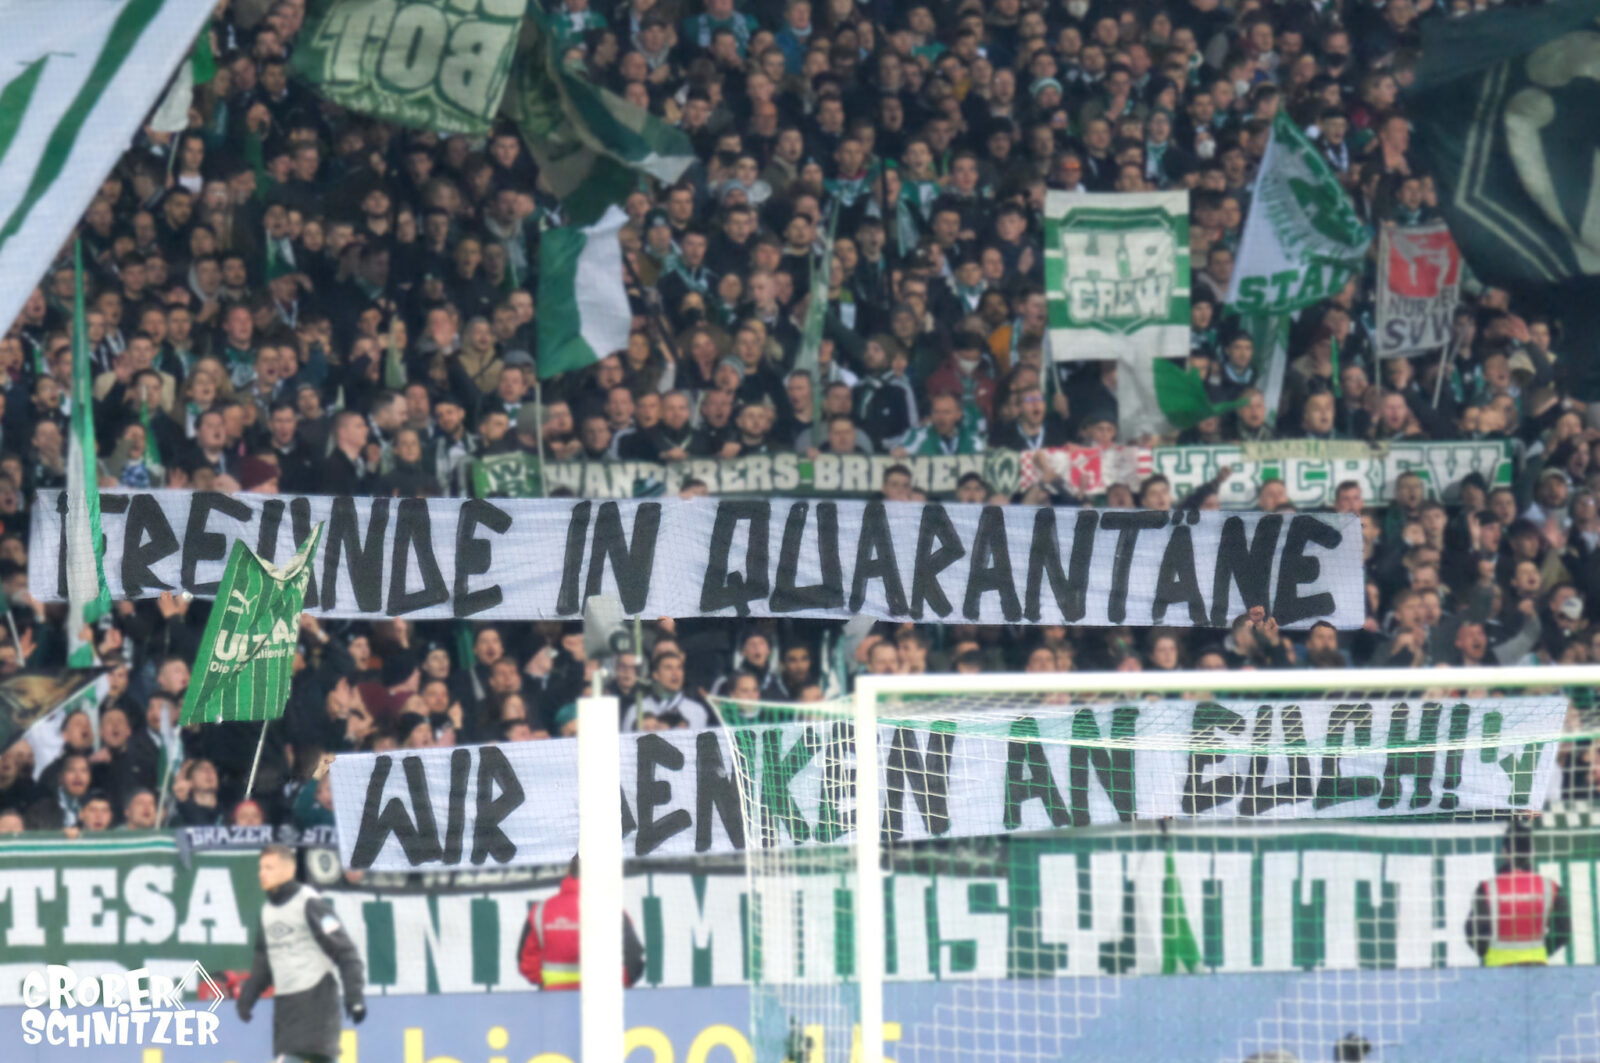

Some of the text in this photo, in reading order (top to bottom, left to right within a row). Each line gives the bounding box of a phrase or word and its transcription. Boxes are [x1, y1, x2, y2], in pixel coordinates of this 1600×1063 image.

[1069, 275, 1171, 322] CREW
[1382, 313, 1457, 350] SVW
[556, 499, 661, 615] IN
[700, 499, 1342, 627] QUARANTÄNE
[349, 745, 525, 869] WIR
[620, 718, 958, 856] ENKEN
[1003, 707, 1140, 830] AN
